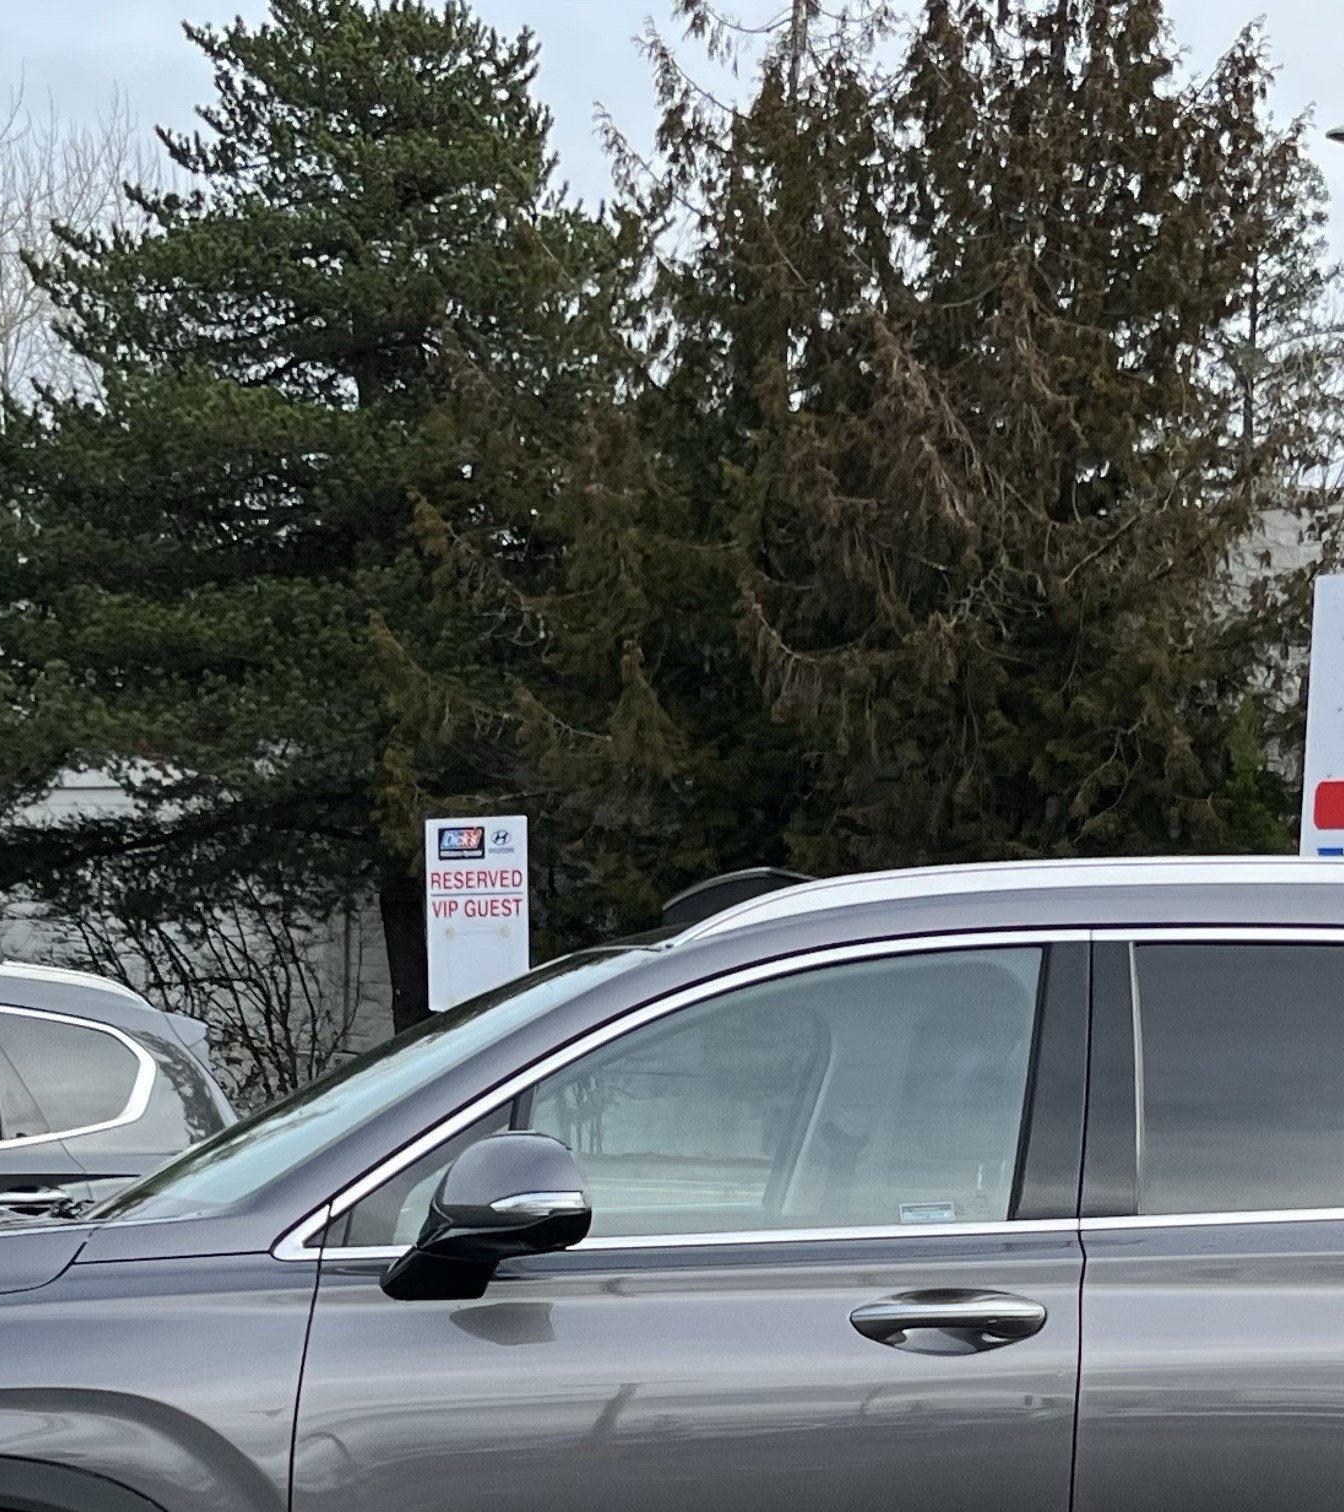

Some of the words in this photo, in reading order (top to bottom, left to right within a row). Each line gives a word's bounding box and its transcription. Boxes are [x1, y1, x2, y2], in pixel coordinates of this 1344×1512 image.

[431, 870, 523, 890] RESERVED
[432, 900, 458, 918] VIP
[464, 898, 522, 918] GUEST
